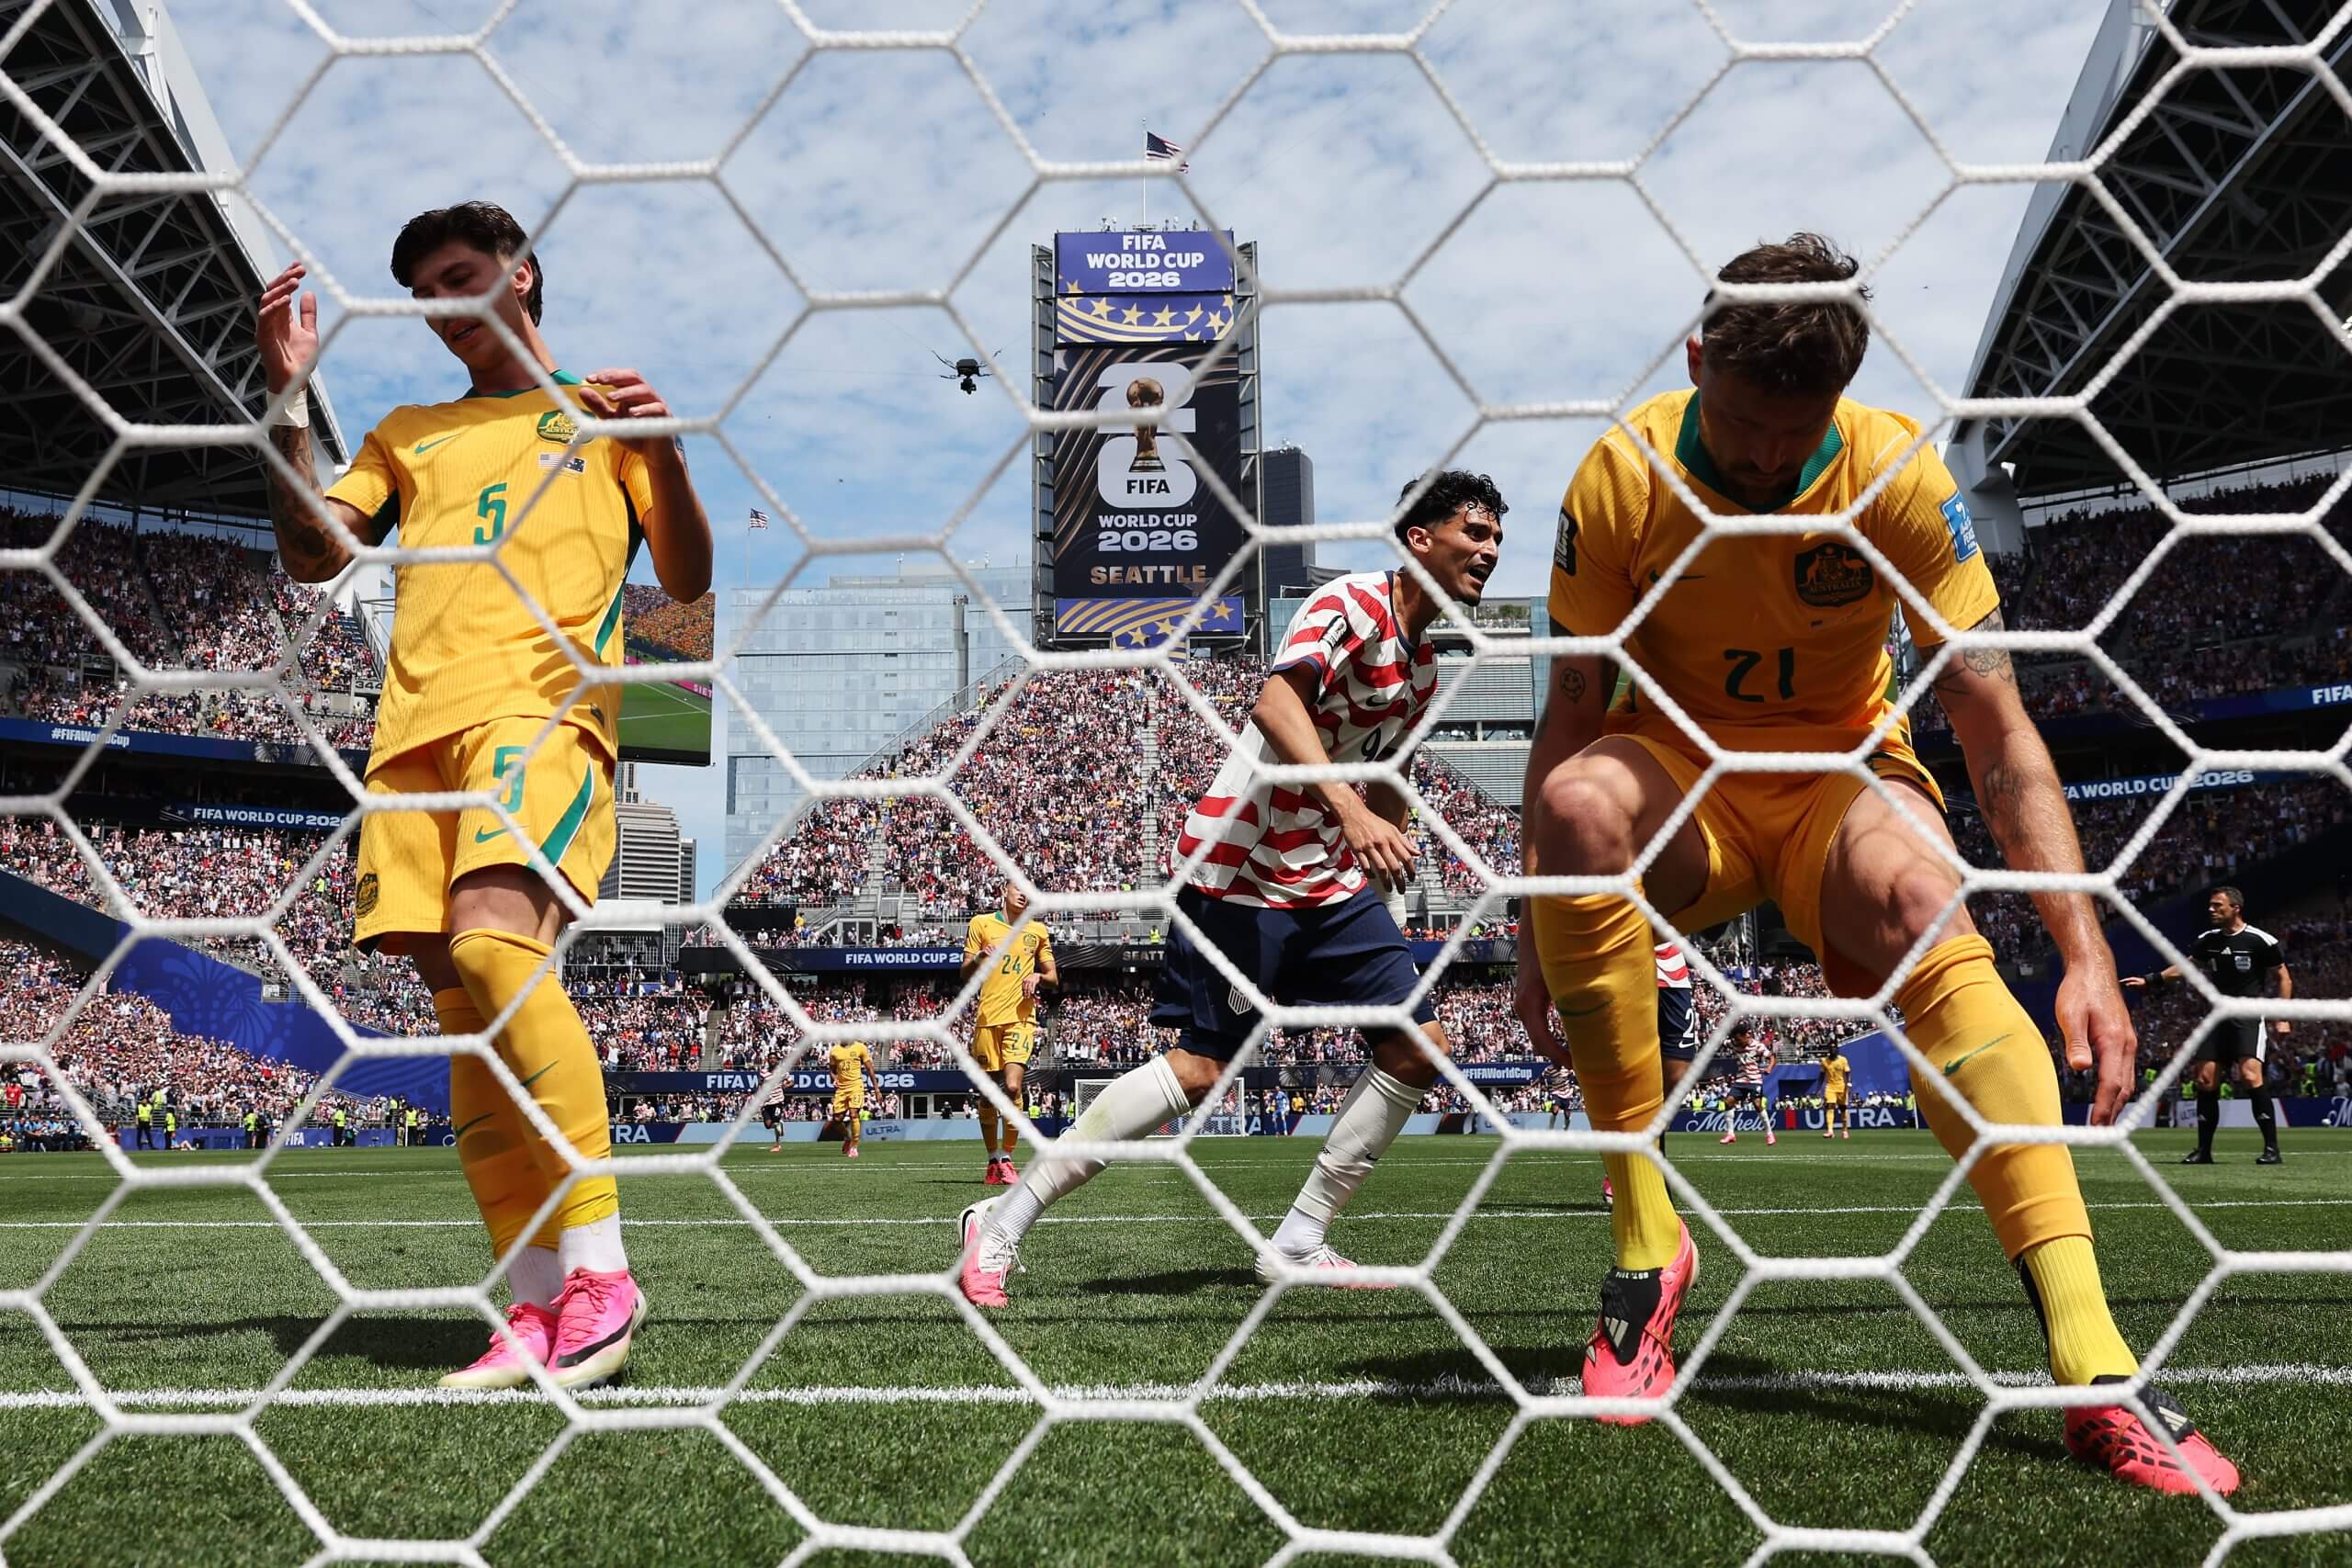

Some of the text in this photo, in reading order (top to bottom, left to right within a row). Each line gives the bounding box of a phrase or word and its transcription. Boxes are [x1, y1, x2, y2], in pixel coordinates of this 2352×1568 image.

[1123, 234, 1166, 250] FIFA
[1087, 253, 1204, 268] WORLD CUP
[1108, 271, 1181, 287] 2026
[1126, 479, 1170, 494] FIFA
[473, 481, 507, 547] 5
[1098, 513, 1197, 528] WORLD CUP
[1098, 530, 1198, 552] 2026
[1090, 565, 1206, 585] SEATTLE
[1723, 647, 1795, 703] 21
[2312, 684, 2352, 705] FIFA
[51, 728, 130, 748] #FIFAWodCup
[492, 745, 526, 814] 5
[2081, 780, 2146, 797] WORLD
[2189, 770, 2255, 788] 2026
[194, 807, 223, 820] FIFA
[225, 810, 275, 823] WORLD
[277, 813, 304, 825] CUP
[845, 953, 873, 964] FIFA
[874, 953, 921, 964] WORLD
[922, 953, 947, 964] CUP
[1001, 954, 1022, 975] 24
[1012, 1032, 1029, 1052] 24
[707, 1074, 745, 1089] FIFA
[747, 1074, 811, 1089] WLD
[814, 1074, 835, 1089] CU
[1463, 1067, 1532, 1080] #FIFAWorldCup
[285, 1131, 305, 1145] FIFA
[865, 1125, 900, 1135] ULTRA
